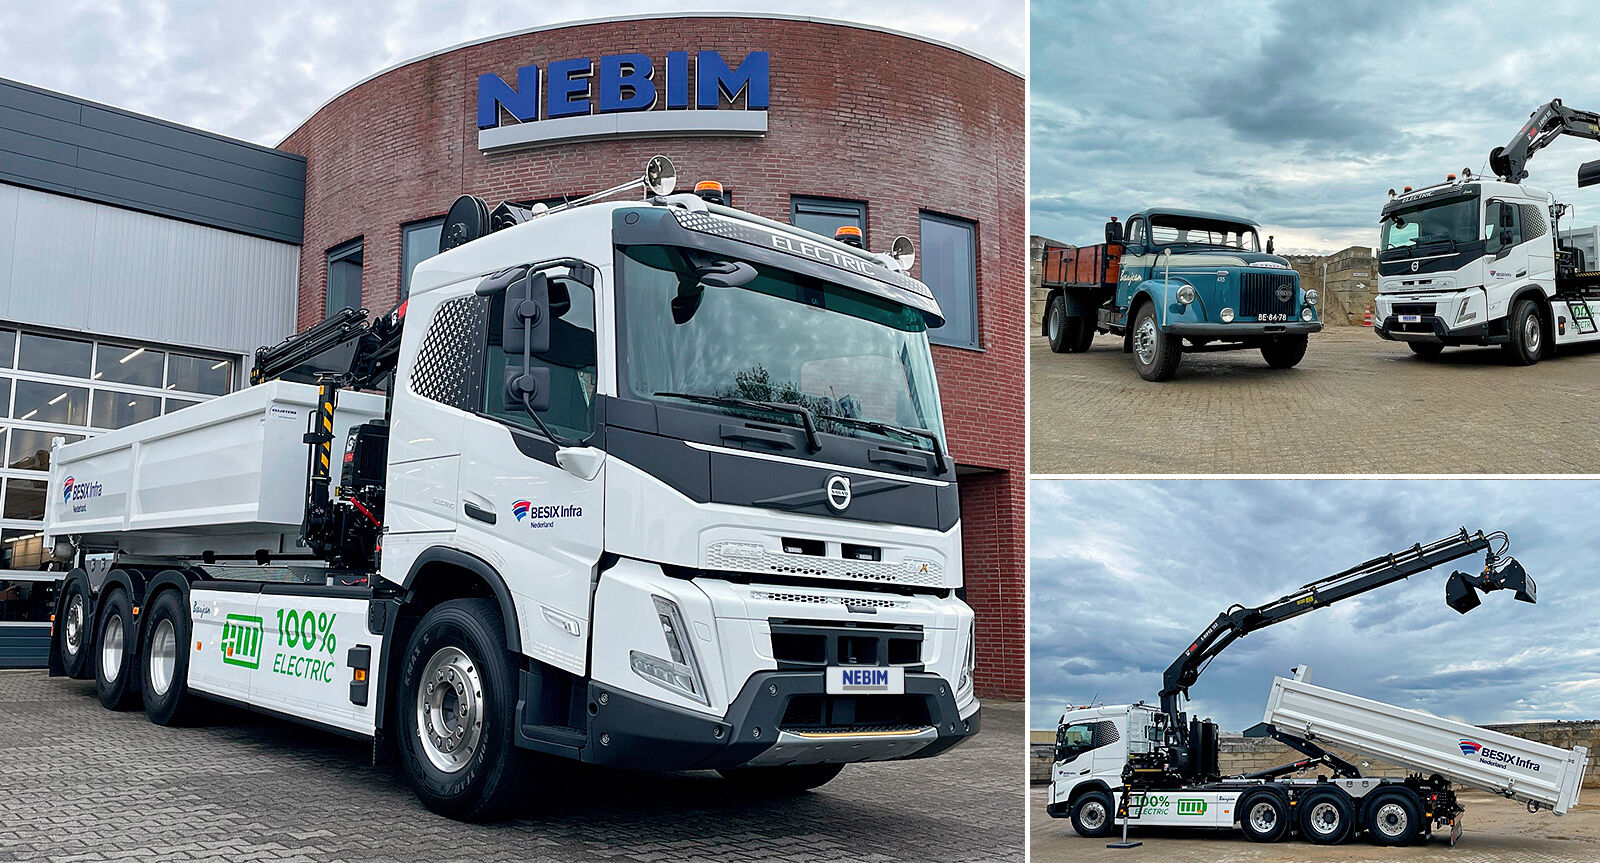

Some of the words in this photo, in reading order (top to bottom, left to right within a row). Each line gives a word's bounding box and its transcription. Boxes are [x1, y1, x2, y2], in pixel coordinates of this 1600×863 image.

[477, 51, 770, 129] NEBIM
[771, 234, 876, 276] ELECTRIC
[73, 482, 91, 501] BESIX
[531, 505, 560, 519] BESIX
[560, 504, 583, 518] Infra
[530, 521, 554, 529] Nederland
[276, 608, 337, 655] 100%
[272, 653, 336, 684] ELECTRIC
[842, 670, 888, 685] NEBIM
[1479, 757, 1507, 770] Nederland
[1481, 747, 1516, 765] BESIX
[1515, 756, 1541, 772] Infra
